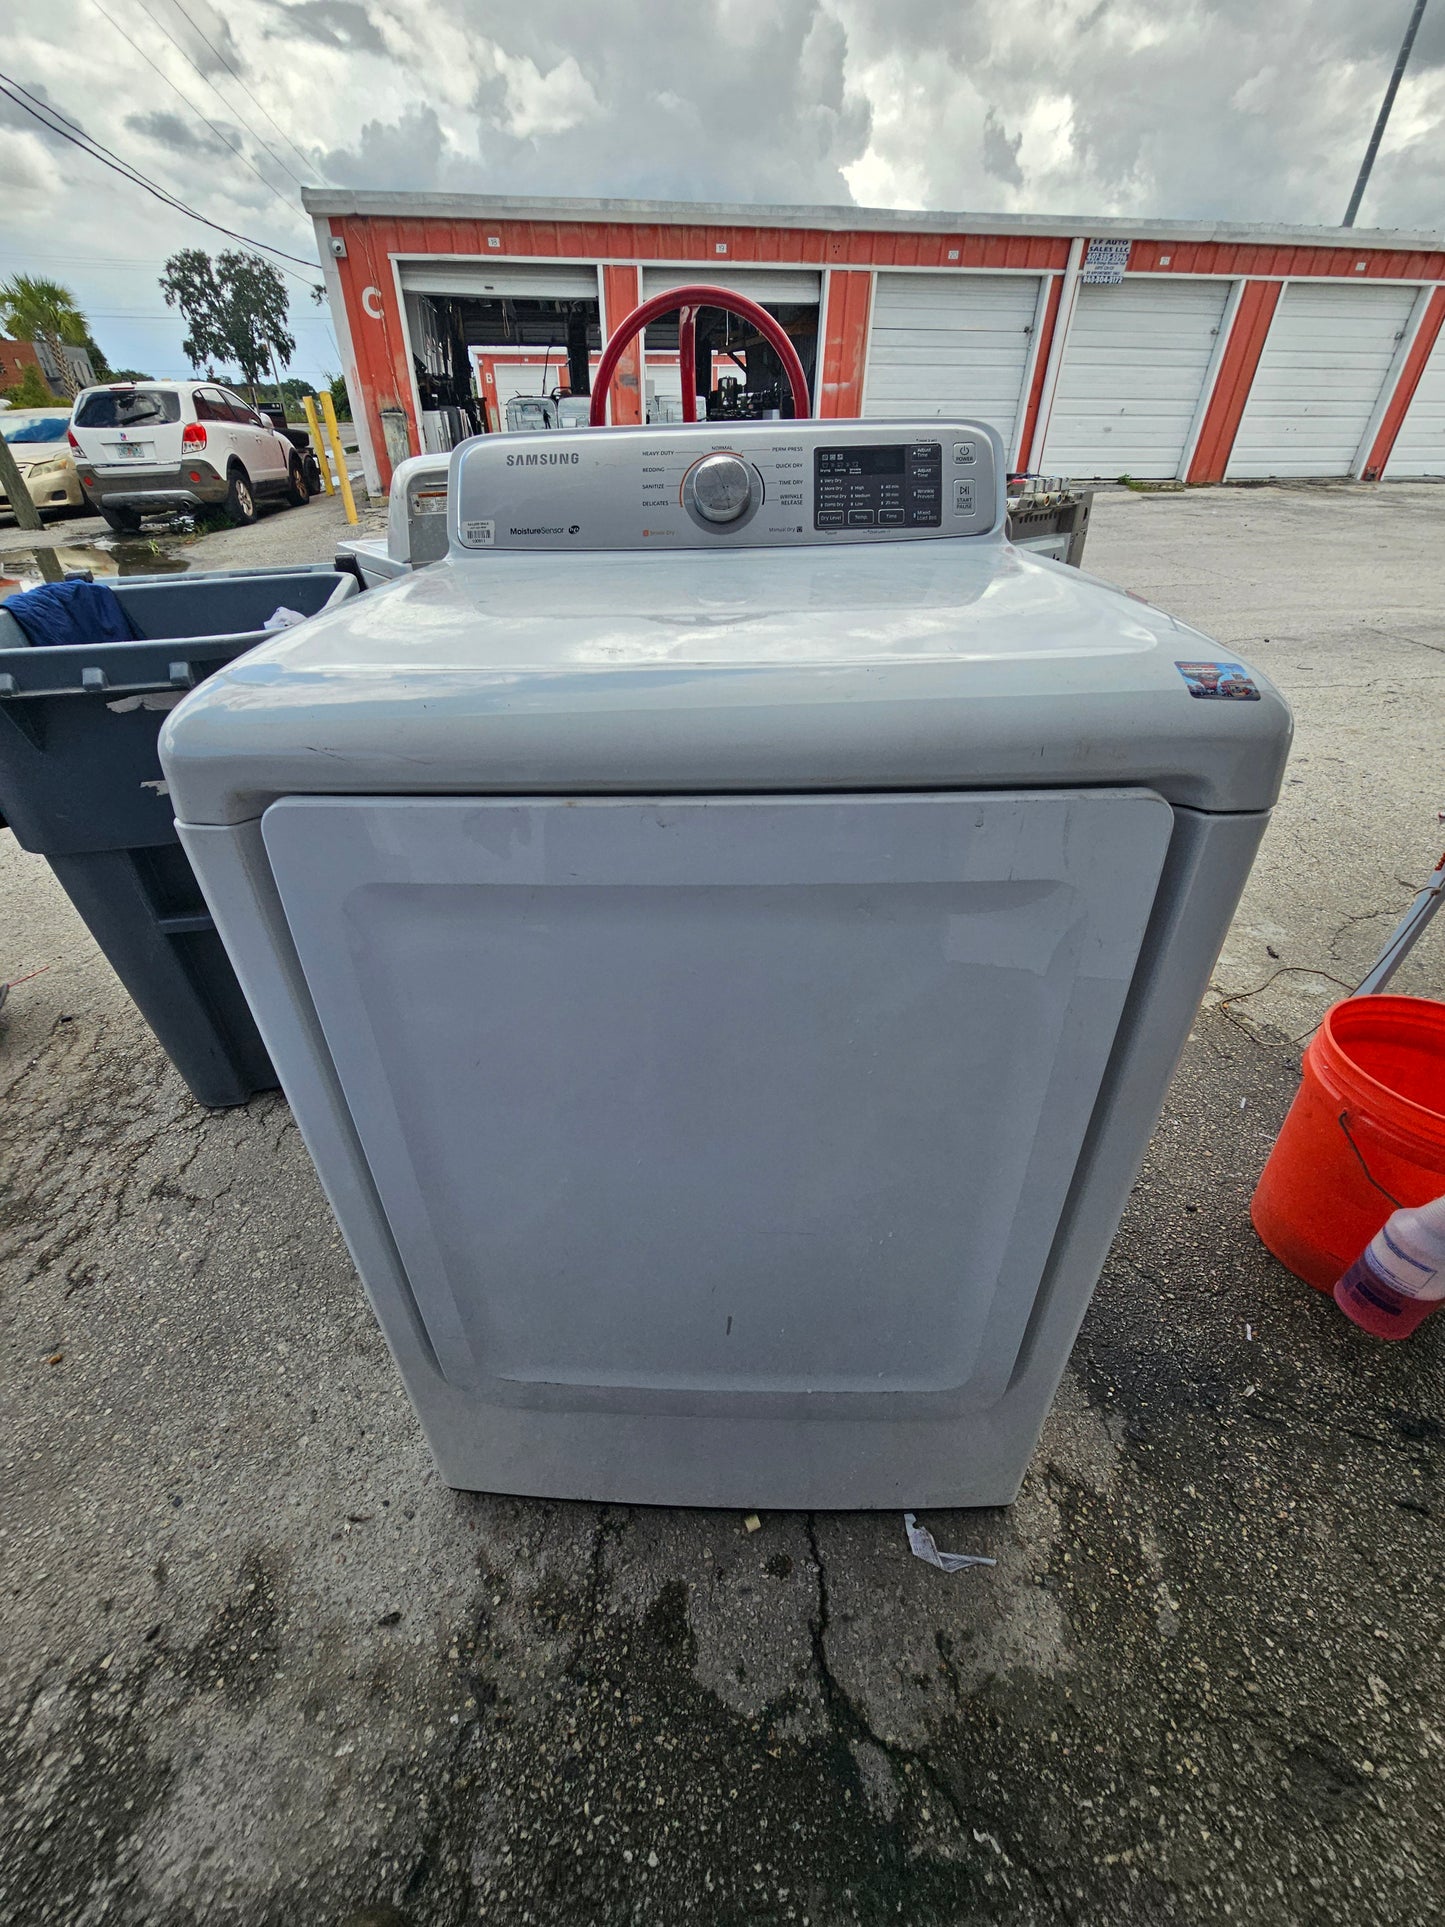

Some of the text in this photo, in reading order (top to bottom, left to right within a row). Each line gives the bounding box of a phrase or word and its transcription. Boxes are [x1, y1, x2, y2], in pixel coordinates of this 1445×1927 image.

[362, 286, 384, 319] C
[486, 373, 493, 384] B
[506, 453, 579, 466] SAMSUNG
[510, 527, 564, 535] MoistureSensor
